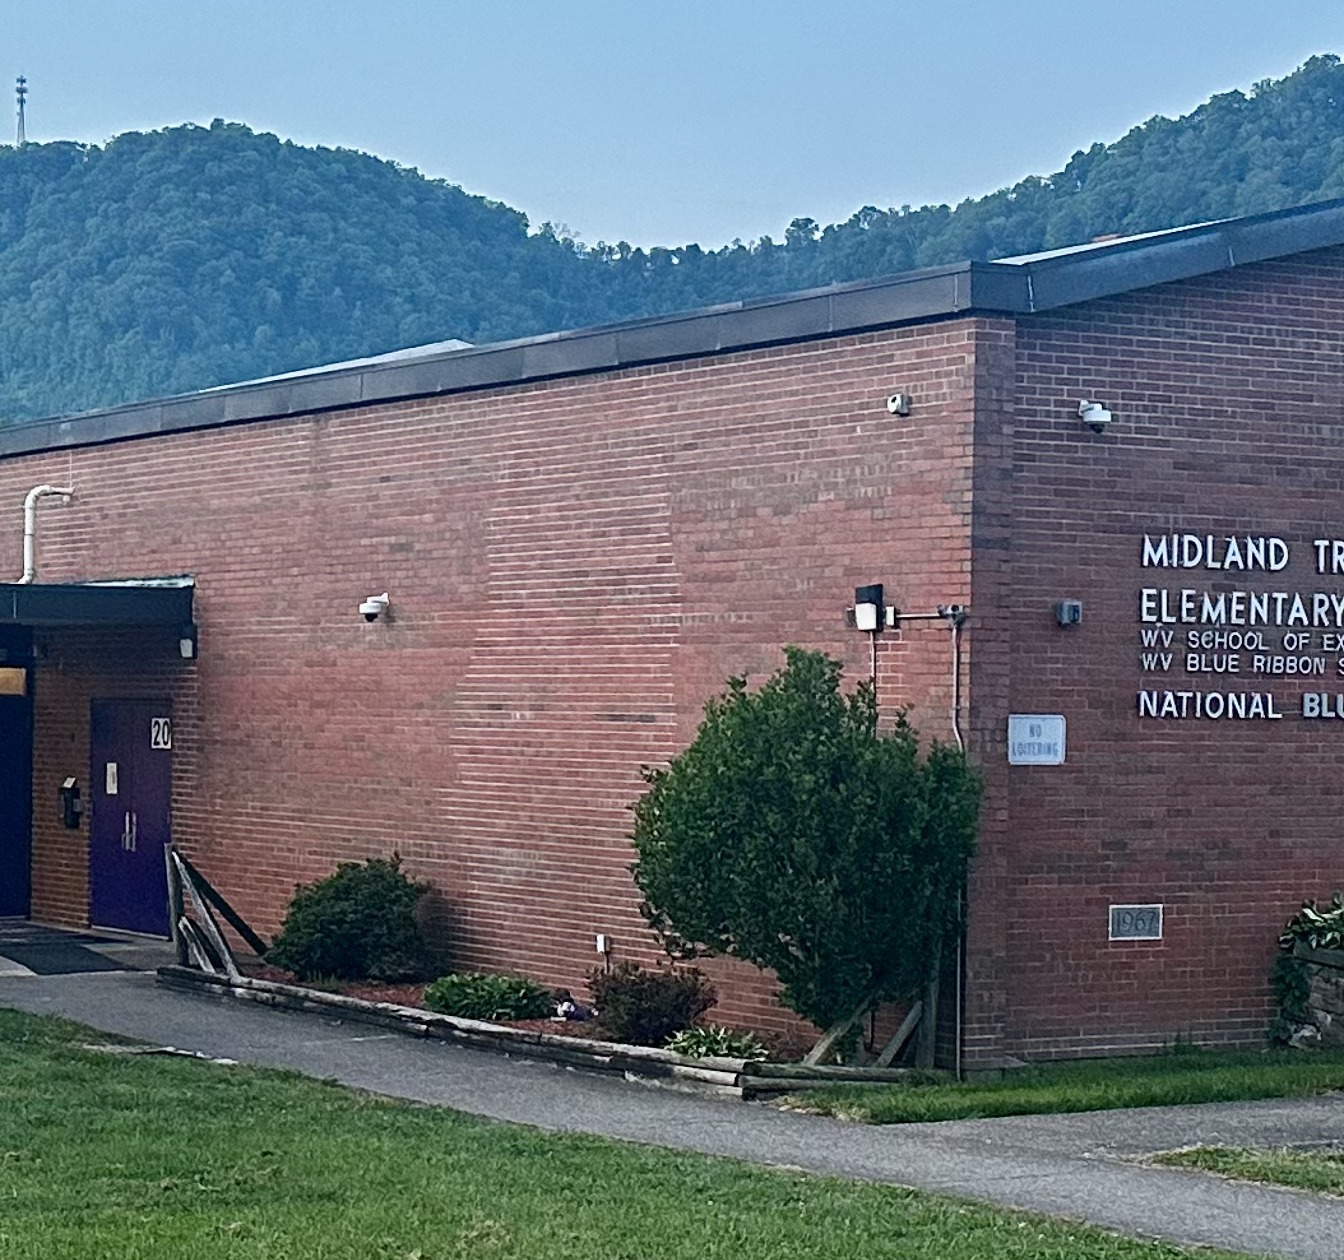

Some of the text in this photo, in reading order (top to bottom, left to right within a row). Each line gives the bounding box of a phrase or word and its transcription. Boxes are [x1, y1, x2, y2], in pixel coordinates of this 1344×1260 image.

[1142, 533, 1290, 571] MIDLAND
[1140, 629, 1174, 648] WV
[1187, 630, 1270, 650] SCHOOL
[1283, 632, 1311, 651] OF
[1141, 653, 1174, 672] WV
[1186, 653, 1241, 673] BLUE
[1253, 655, 1326, 674] RIBBON
[1138, 691, 1283, 719] NATIONAL
[153, 720, 170, 746] 20
[1028, 723, 1043, 738] NO
[1116, 910, 1156, 934] 1967
